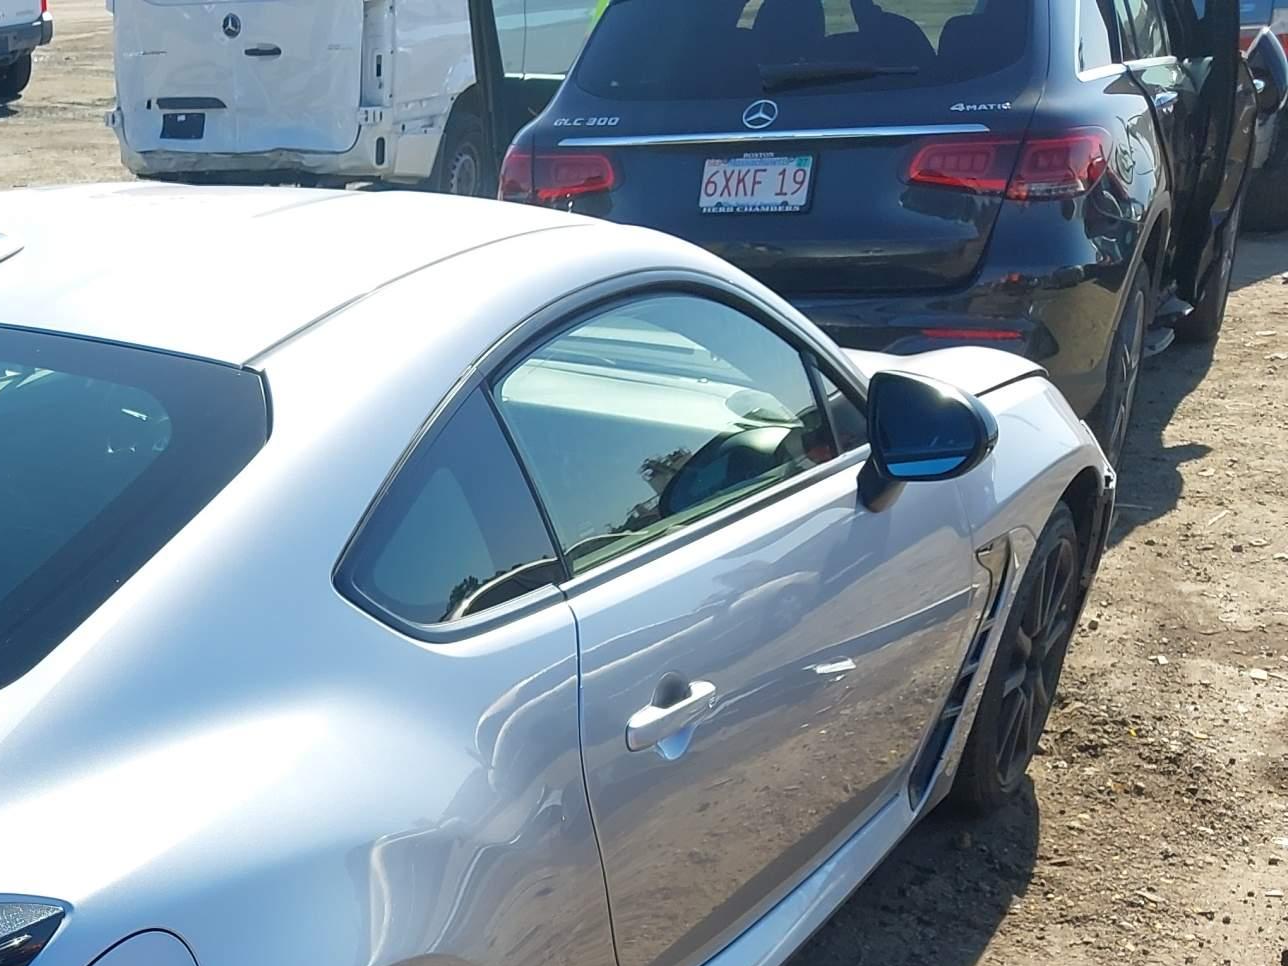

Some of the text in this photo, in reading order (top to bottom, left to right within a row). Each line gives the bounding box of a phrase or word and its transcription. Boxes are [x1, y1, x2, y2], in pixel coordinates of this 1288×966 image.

[553, 116, 620, 126] GLC 300
[704, 168, 807, 198] 6XKF 19
